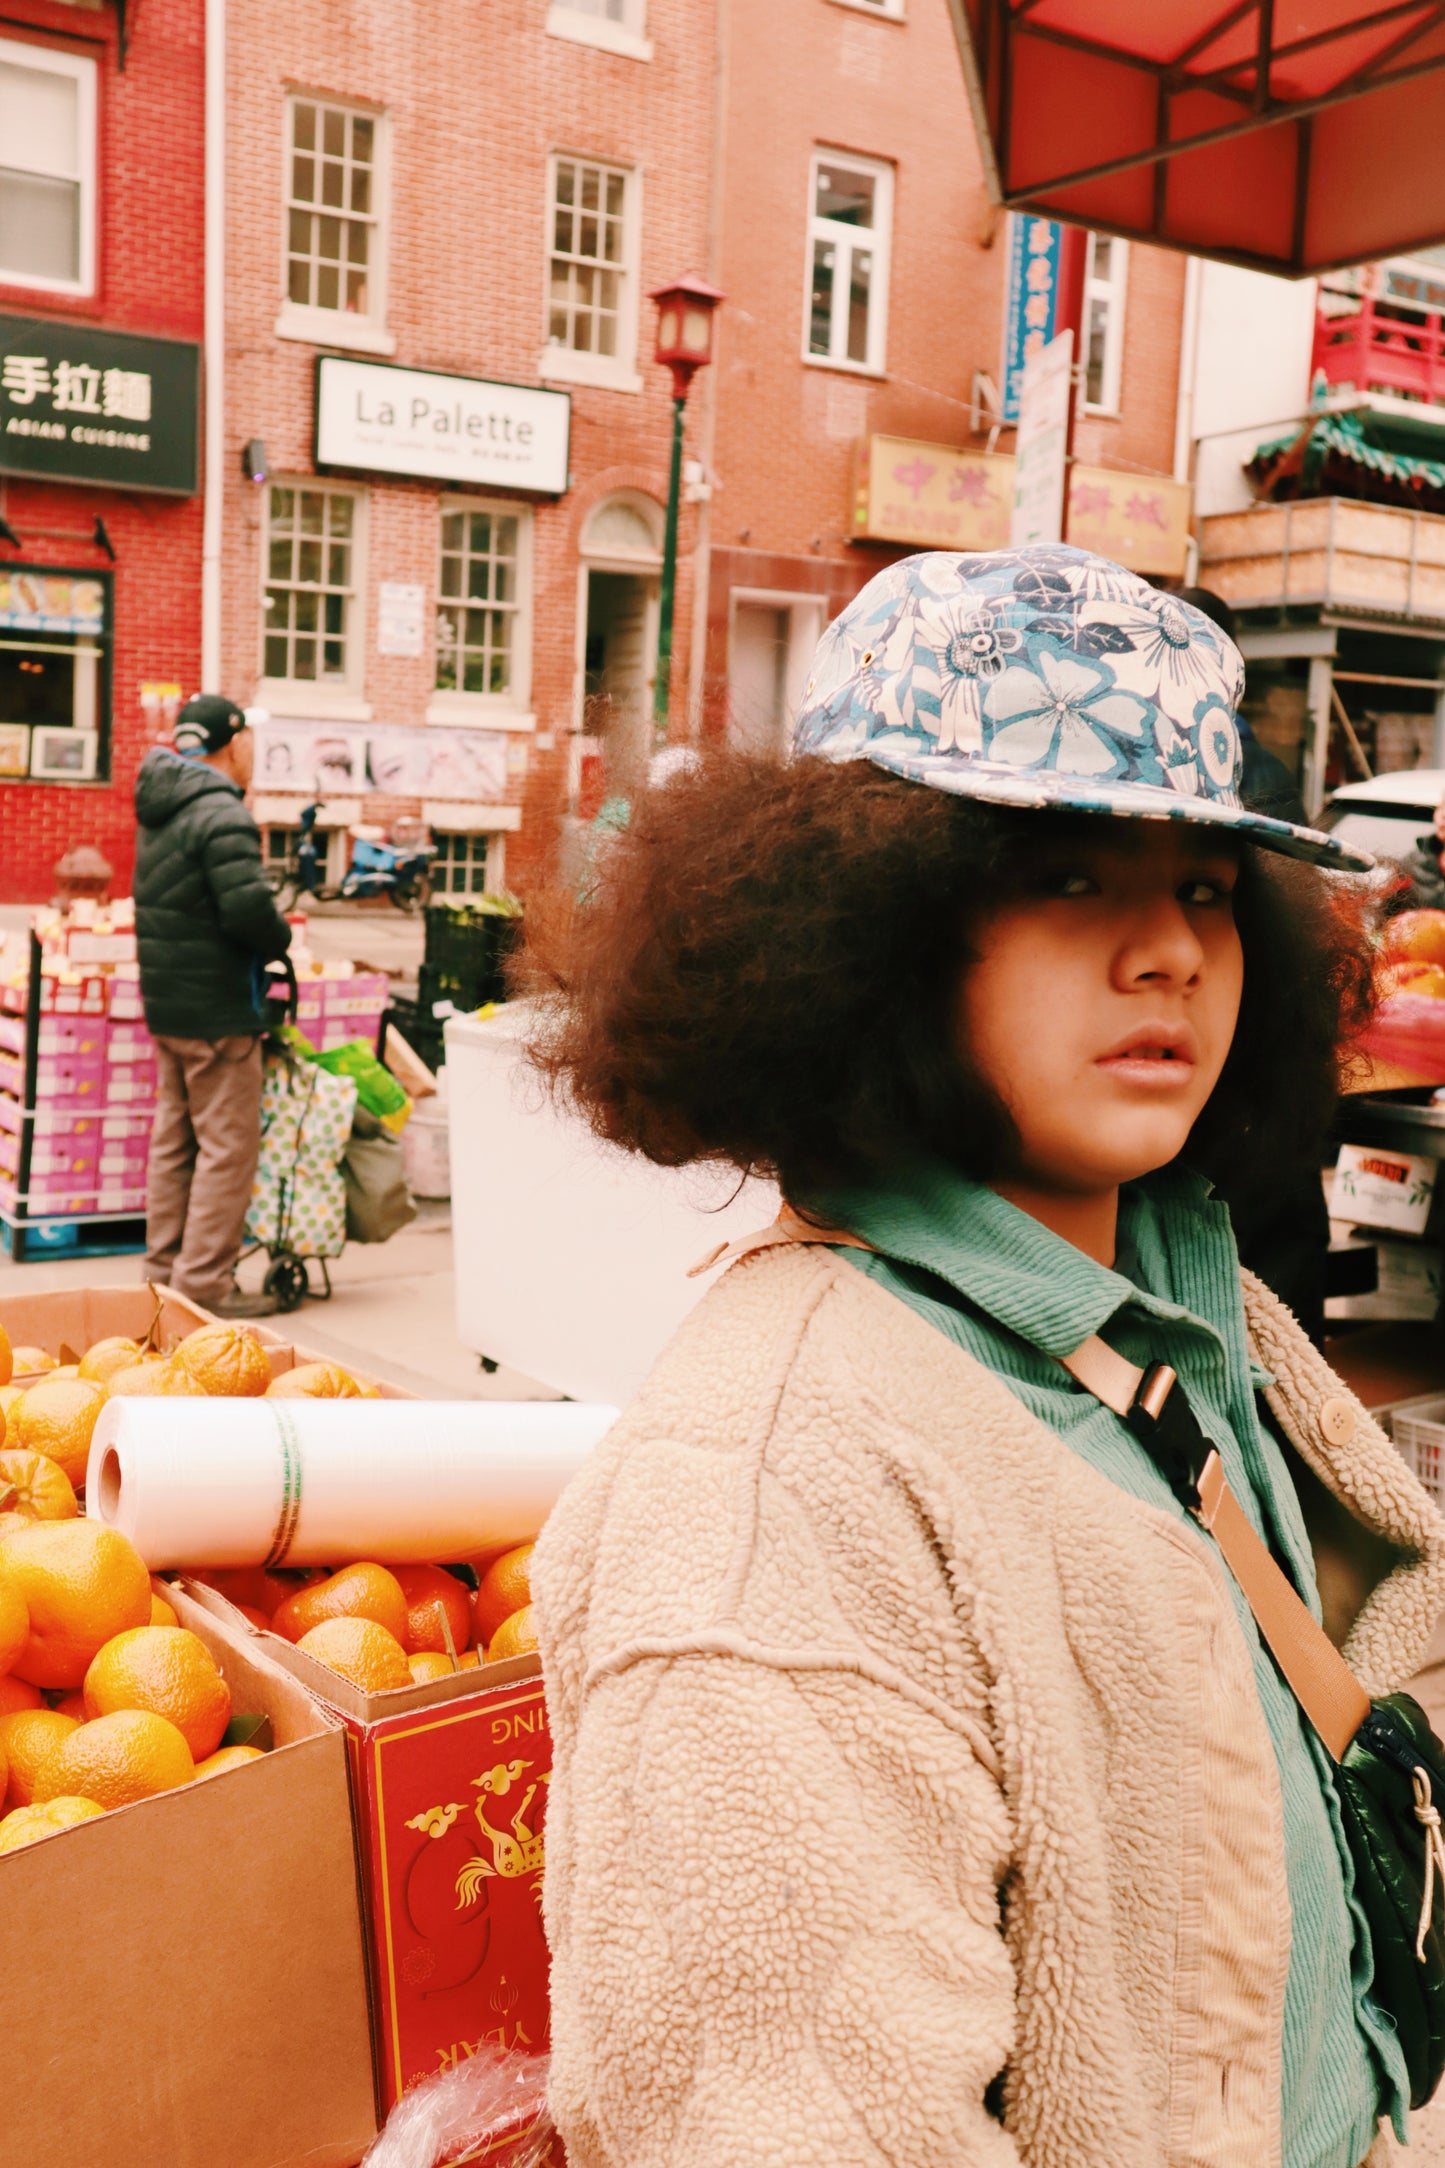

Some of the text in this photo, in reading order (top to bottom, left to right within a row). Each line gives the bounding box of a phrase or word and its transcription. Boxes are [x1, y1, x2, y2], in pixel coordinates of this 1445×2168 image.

[6, 417, 150, 451] ASIAN CUISINE
[355, 390, 395, 426] La
[410, 397, 533, 445] Palette
[491, 1707, 545, 1745] ING
